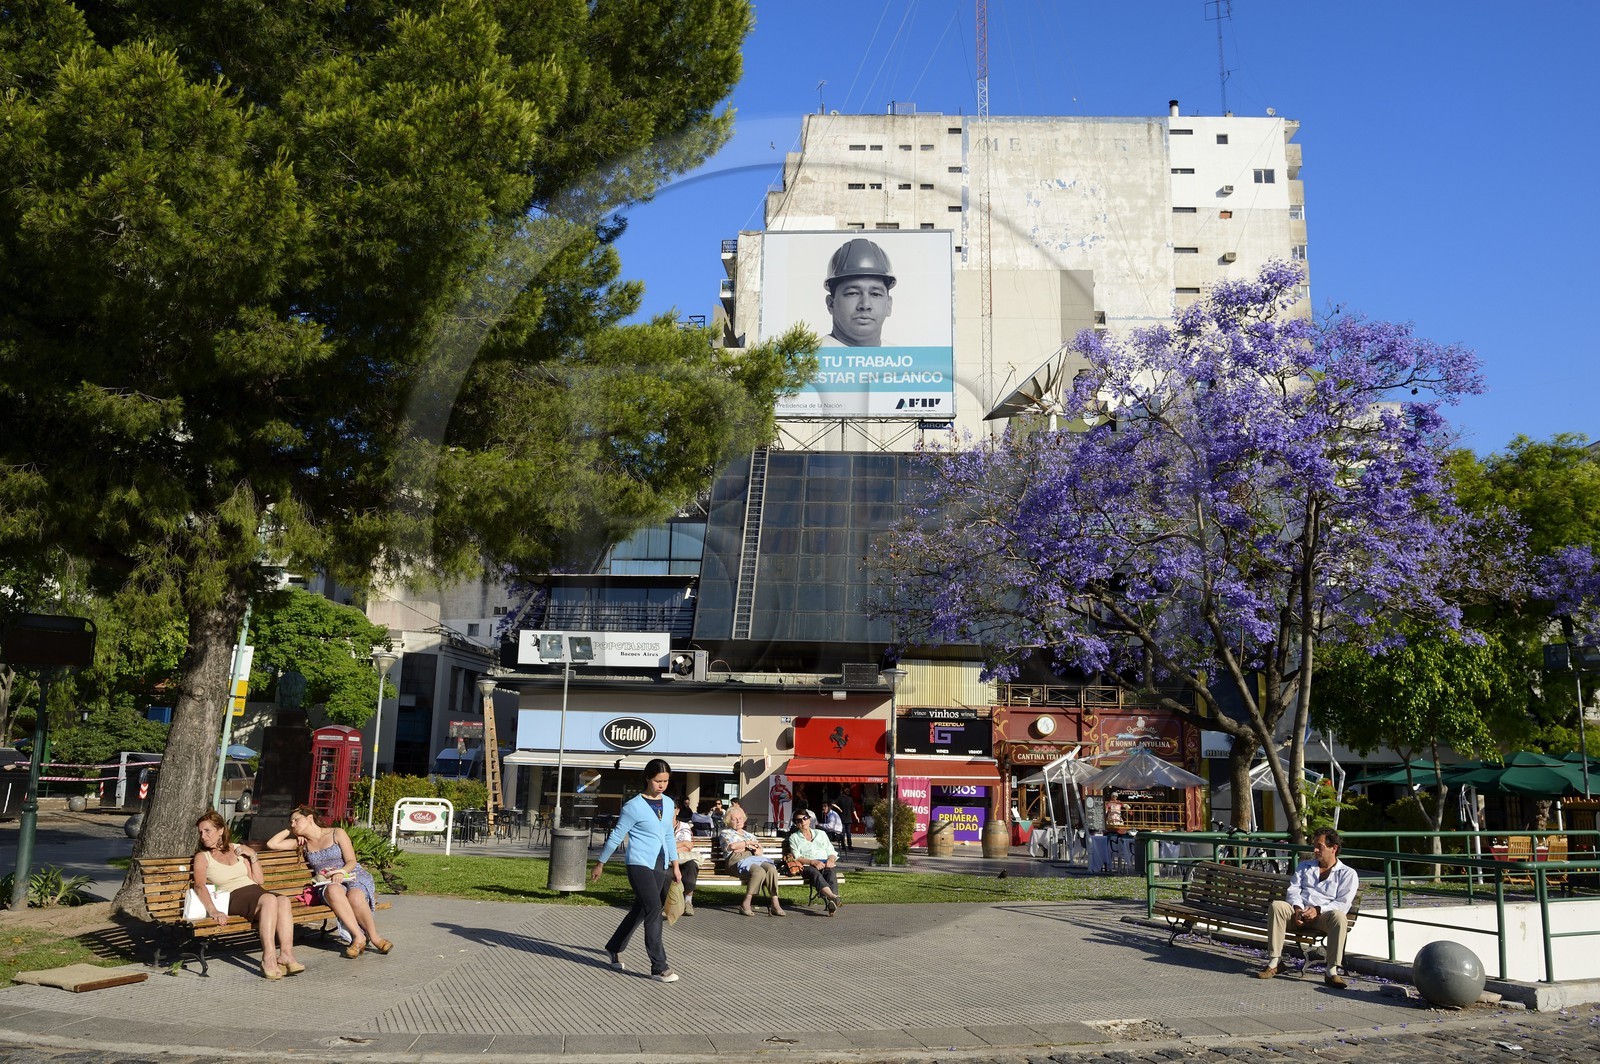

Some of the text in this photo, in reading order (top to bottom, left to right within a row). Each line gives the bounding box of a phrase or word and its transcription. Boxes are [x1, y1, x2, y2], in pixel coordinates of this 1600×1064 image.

[822, 355, 843, 368] TU
[845, 355, 914, 368] TRABAJO
[858, 371, 880, 384] EN
[882, 371, 944, 384] BLANCO
[895, 398, 941, 409] AFIP
[593, 641, 661, 651] POPOTAMUS
[928, 708, 960, 719] vinhos
[611, 724, 648, 742] freddo
[1017, 753, 1045, 761] CANTINA
[902, 789, 927, 799] VINOS
[941, 785, 977, 795] VINOS
[939, 813, 979, 823] PRIMERA
